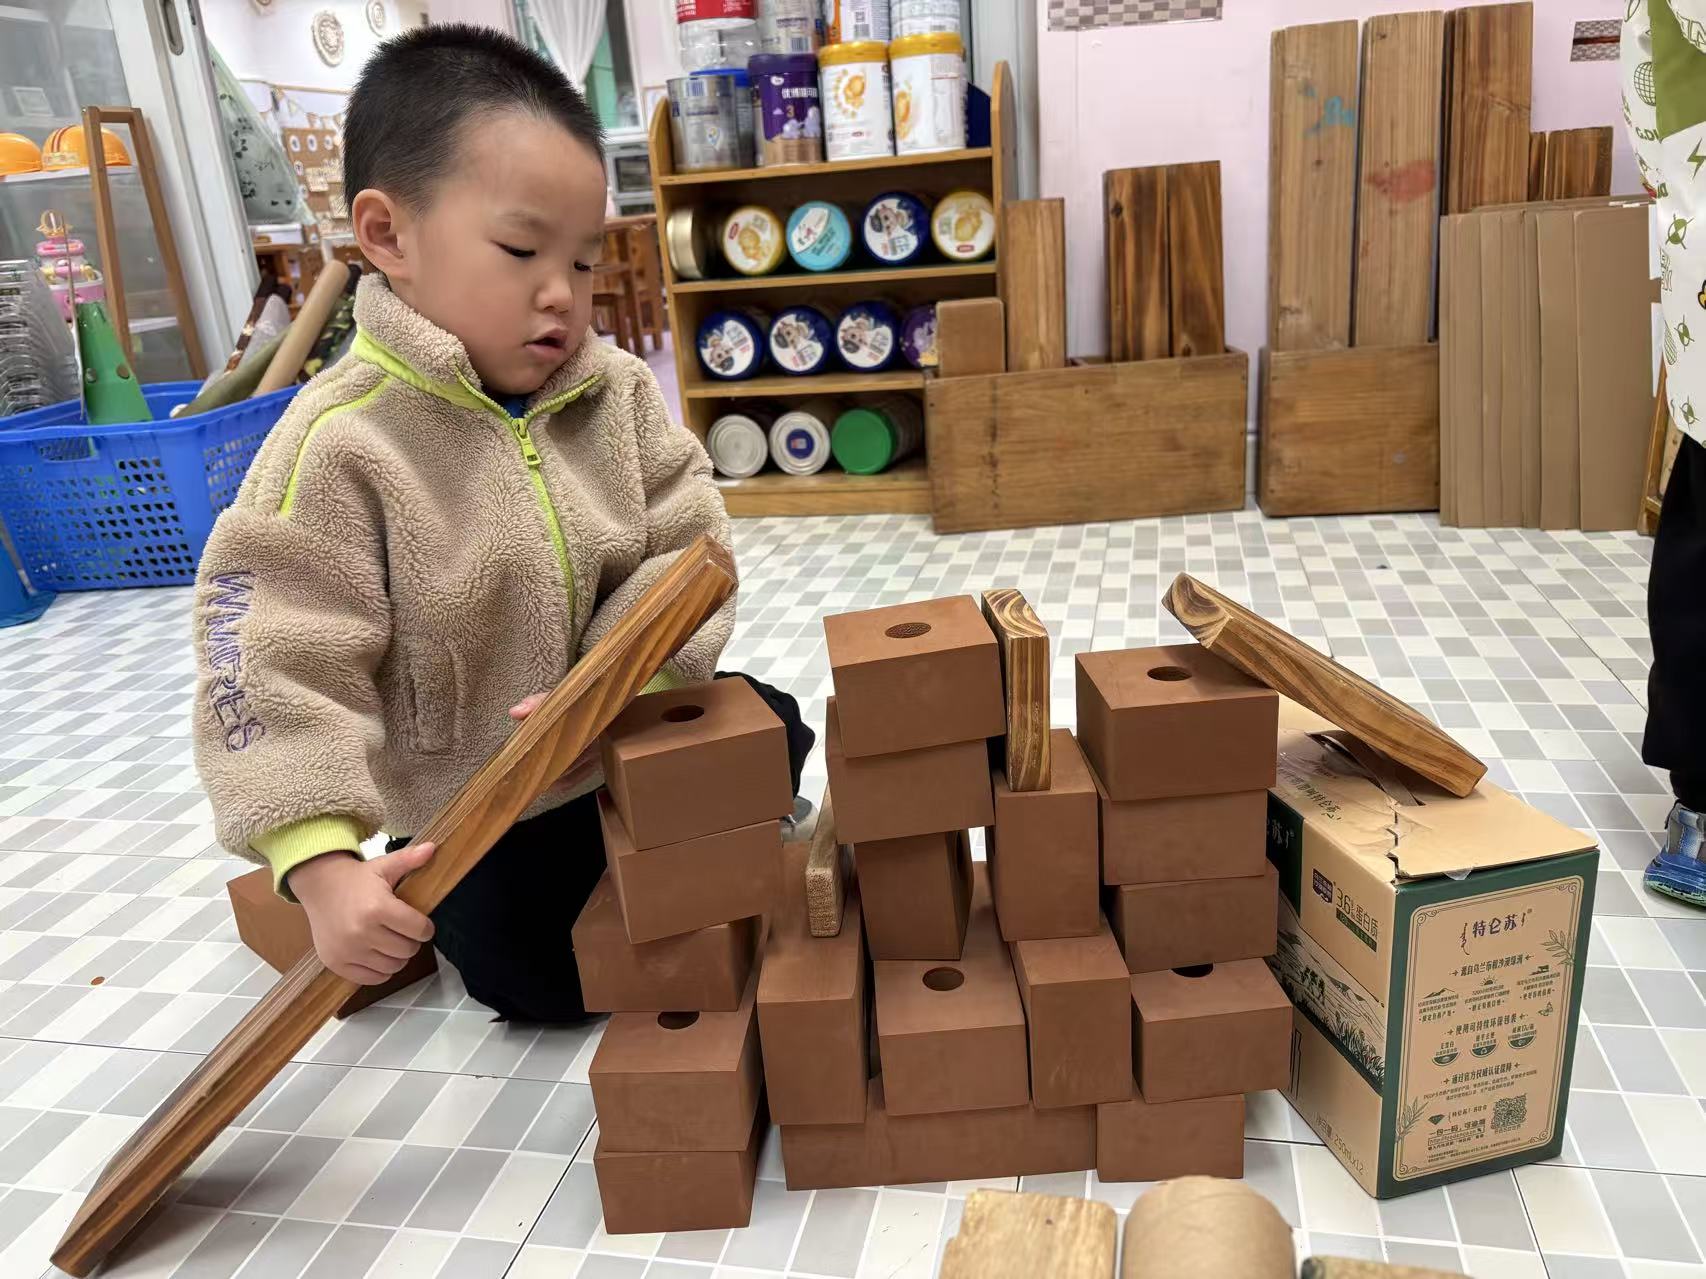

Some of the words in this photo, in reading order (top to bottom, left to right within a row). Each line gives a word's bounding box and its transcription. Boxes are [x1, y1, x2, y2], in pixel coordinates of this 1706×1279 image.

[1355, 904, 1378, 938] 蛋白质
[1472, 914, 1518, 938] 特仑苏
